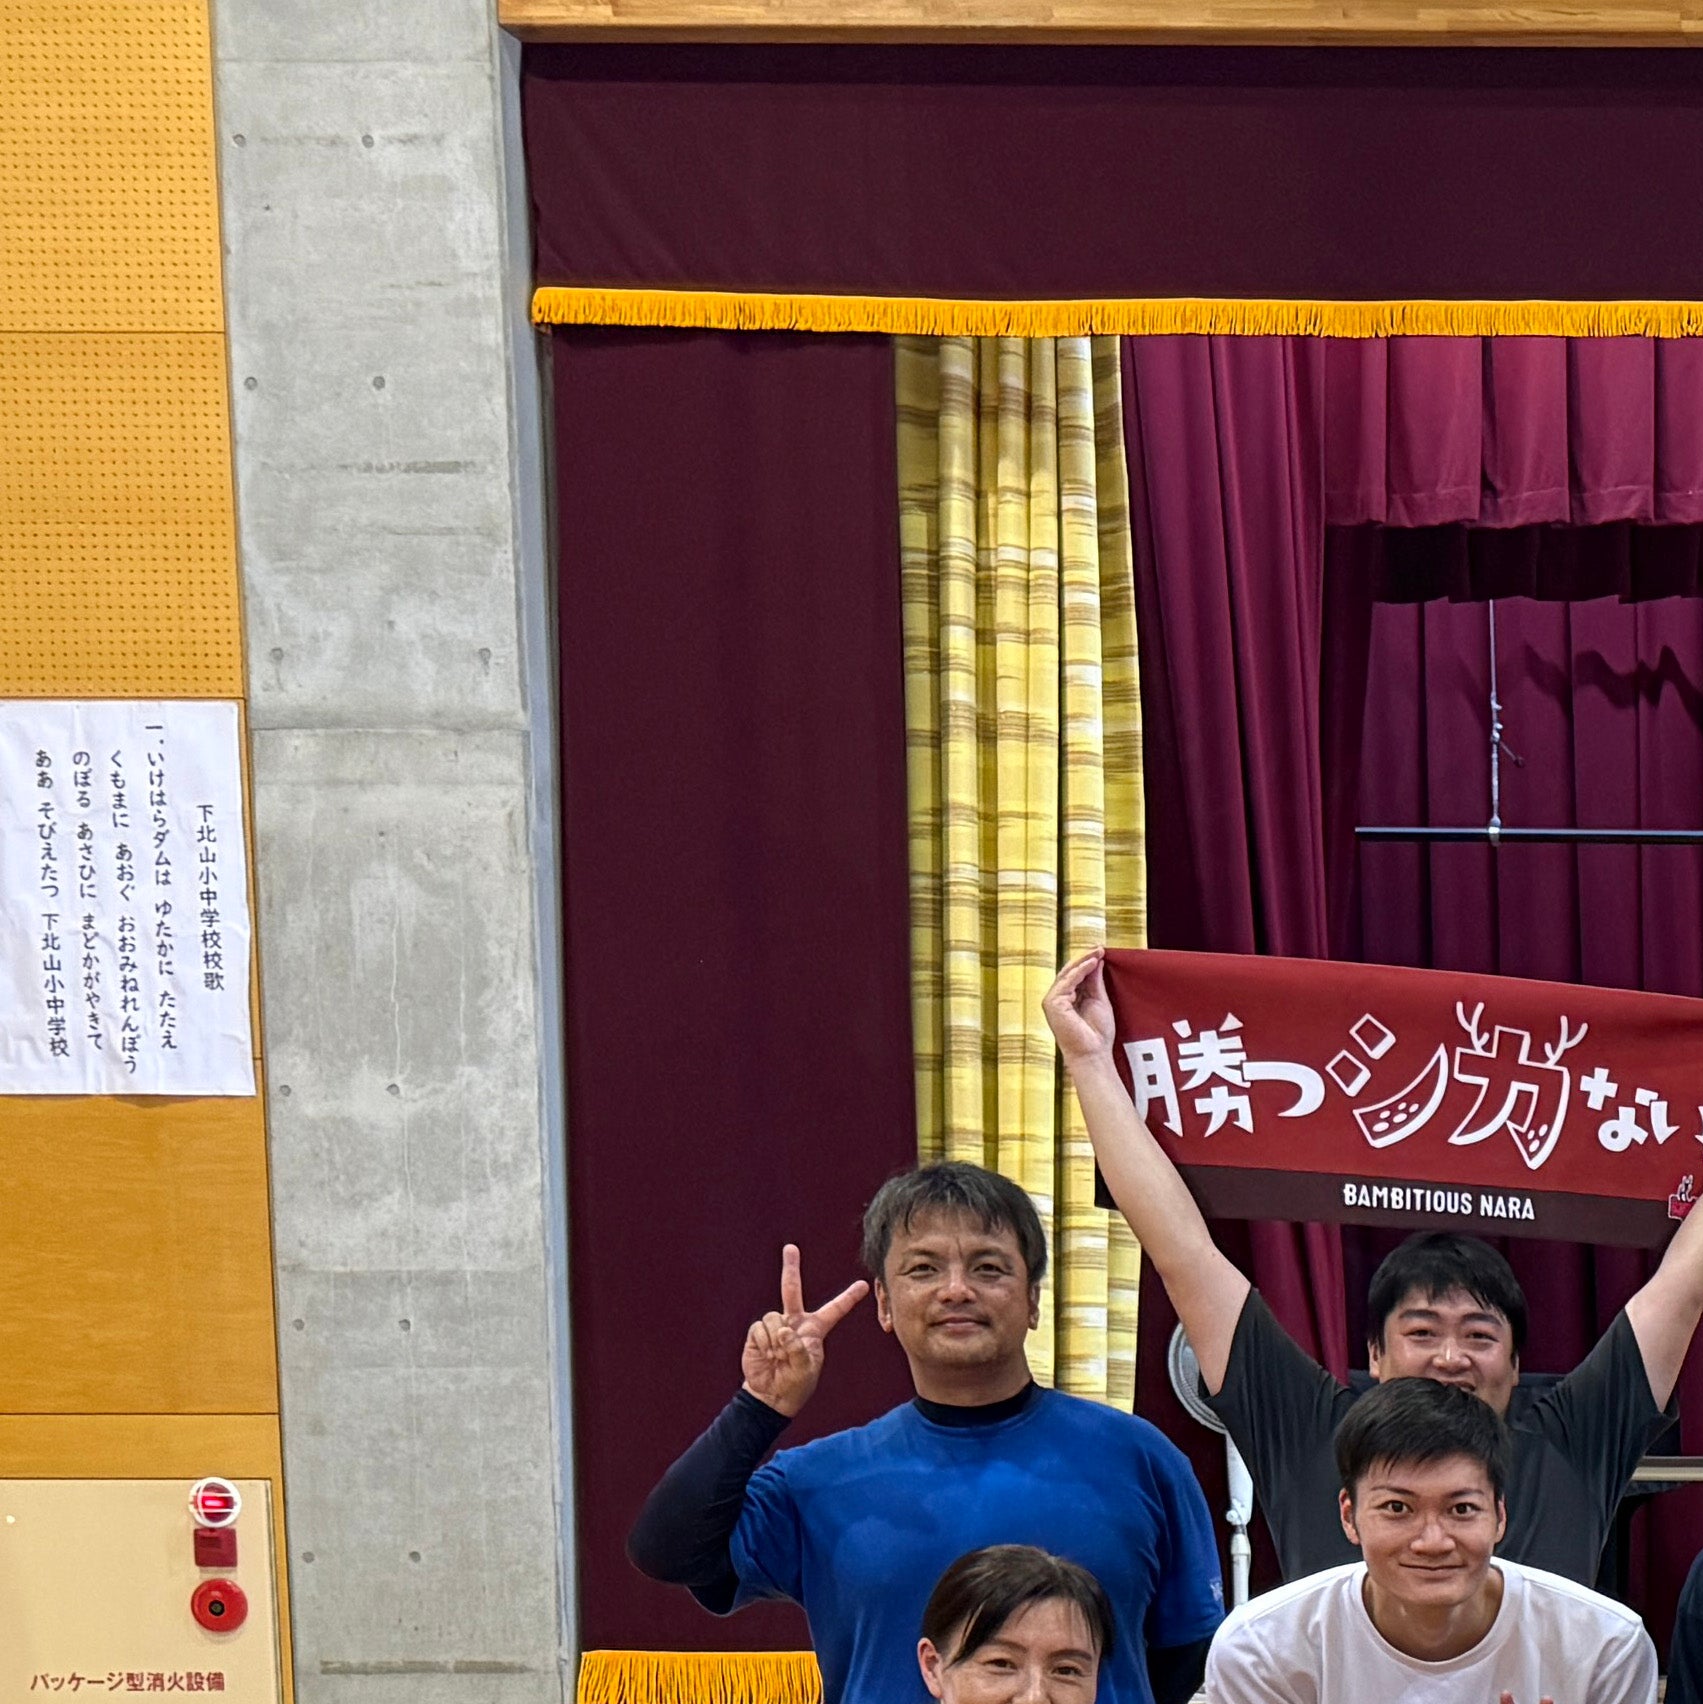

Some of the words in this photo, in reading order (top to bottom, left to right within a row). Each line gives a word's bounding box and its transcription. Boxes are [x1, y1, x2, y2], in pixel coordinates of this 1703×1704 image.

[35, 749, 53, 789] ああ
[109, 749, 130, 829] くもまに
[37, 801, 59, 898] そびえたつ
[76, 822, 97, 899] あさひに
[115, 842, 135, 902] あおぐ
[197, 804, 225, 991] 下北山小中学校校歌
[154, 900, 174, 976] ゆたかに
[41, 913, 70, 1057] 下北山小中学校
[158, 990, 177, 1049] たたえ
[1343, 1183, 1472, 1215] BAMBITIOUS
[1479, 1194, 1536, 1221] NARA
[30, 1671, 226, 1693] パッケージ型消火設備
